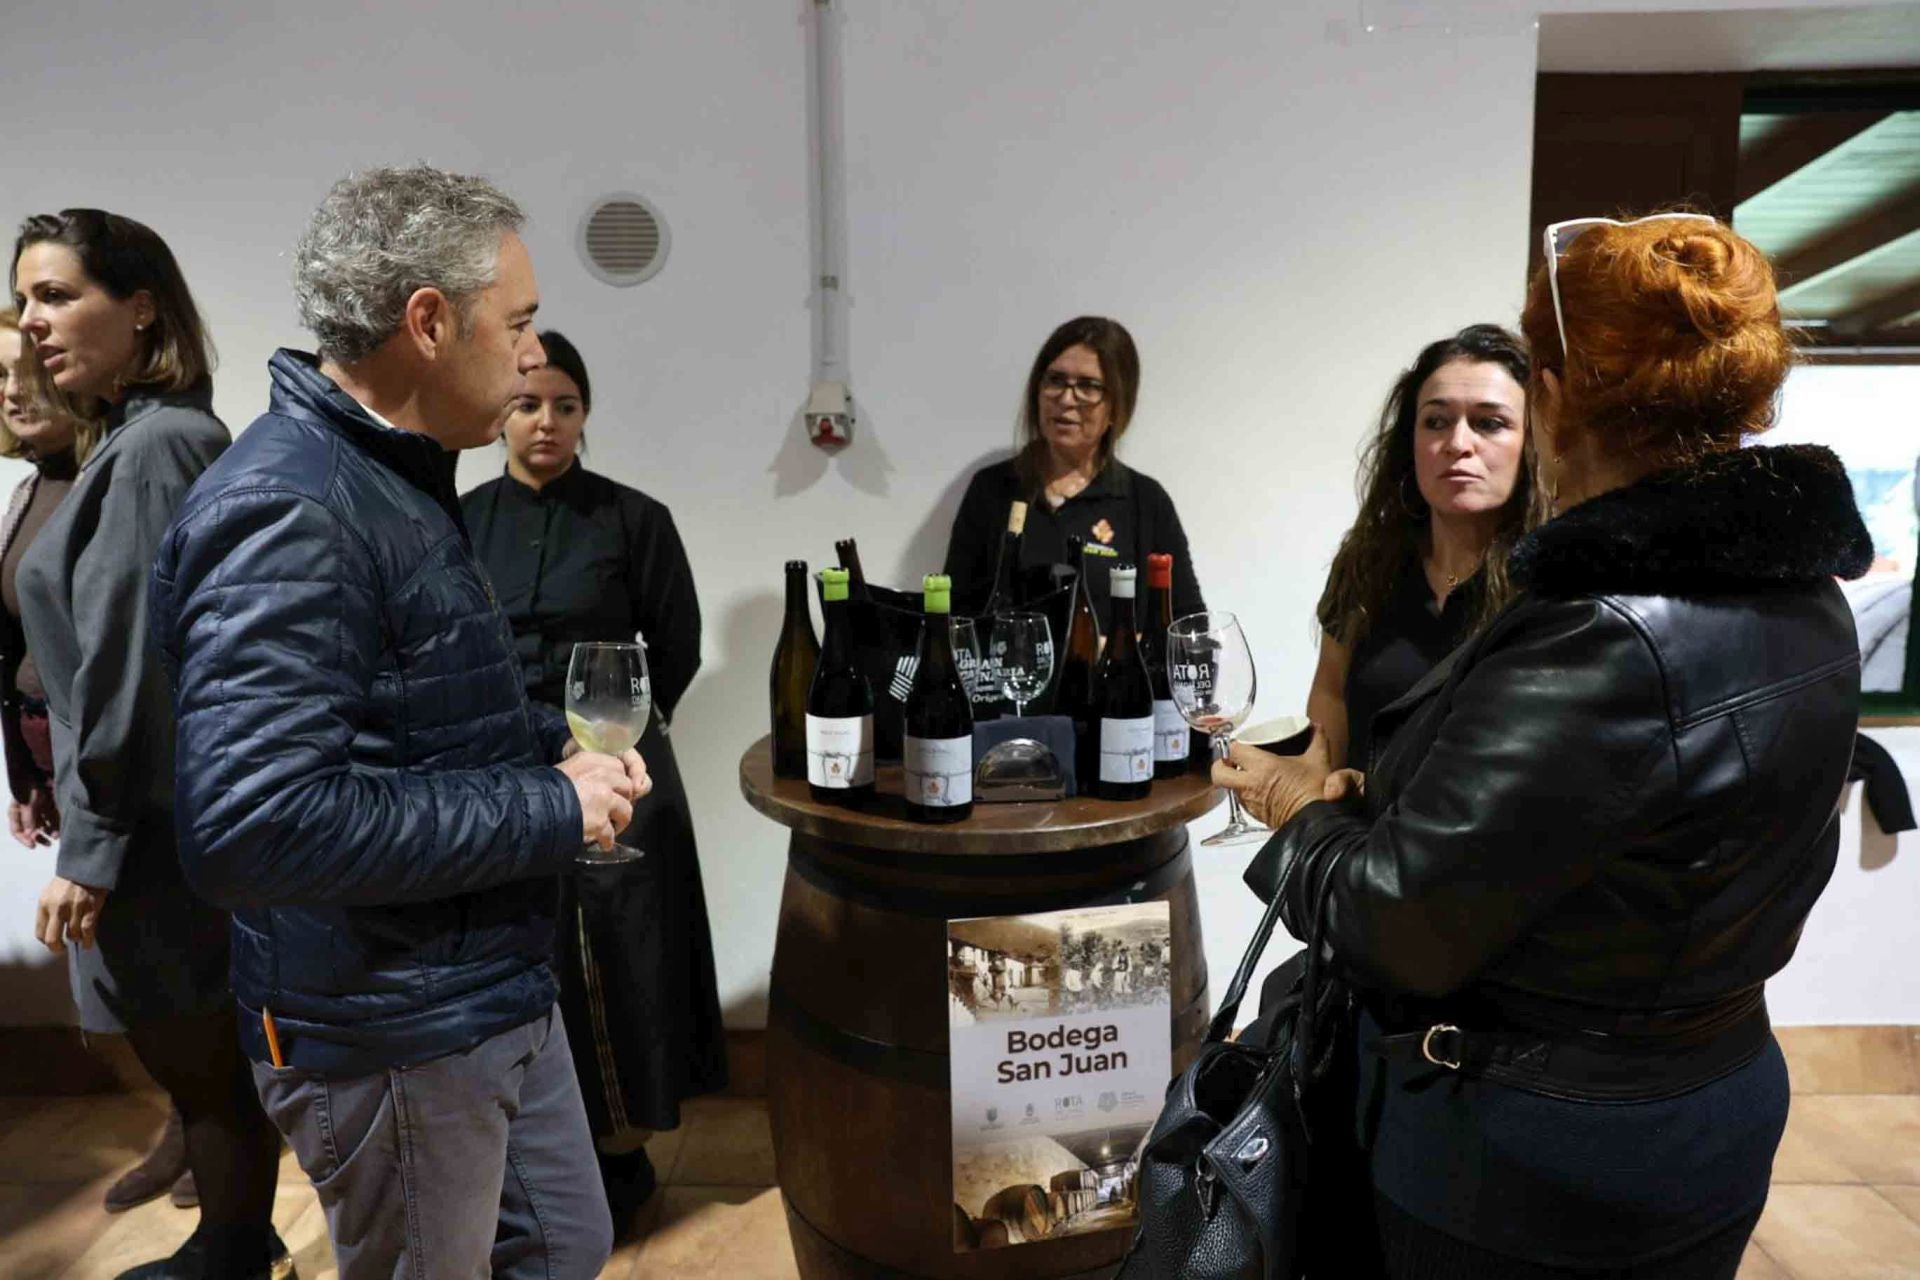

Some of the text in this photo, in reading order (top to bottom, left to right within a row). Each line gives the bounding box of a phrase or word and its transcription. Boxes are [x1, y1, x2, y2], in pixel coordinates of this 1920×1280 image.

[1007, 1024, 1119, 1055] Bodega
[997, 1050, 1128, 1084] San Juan
